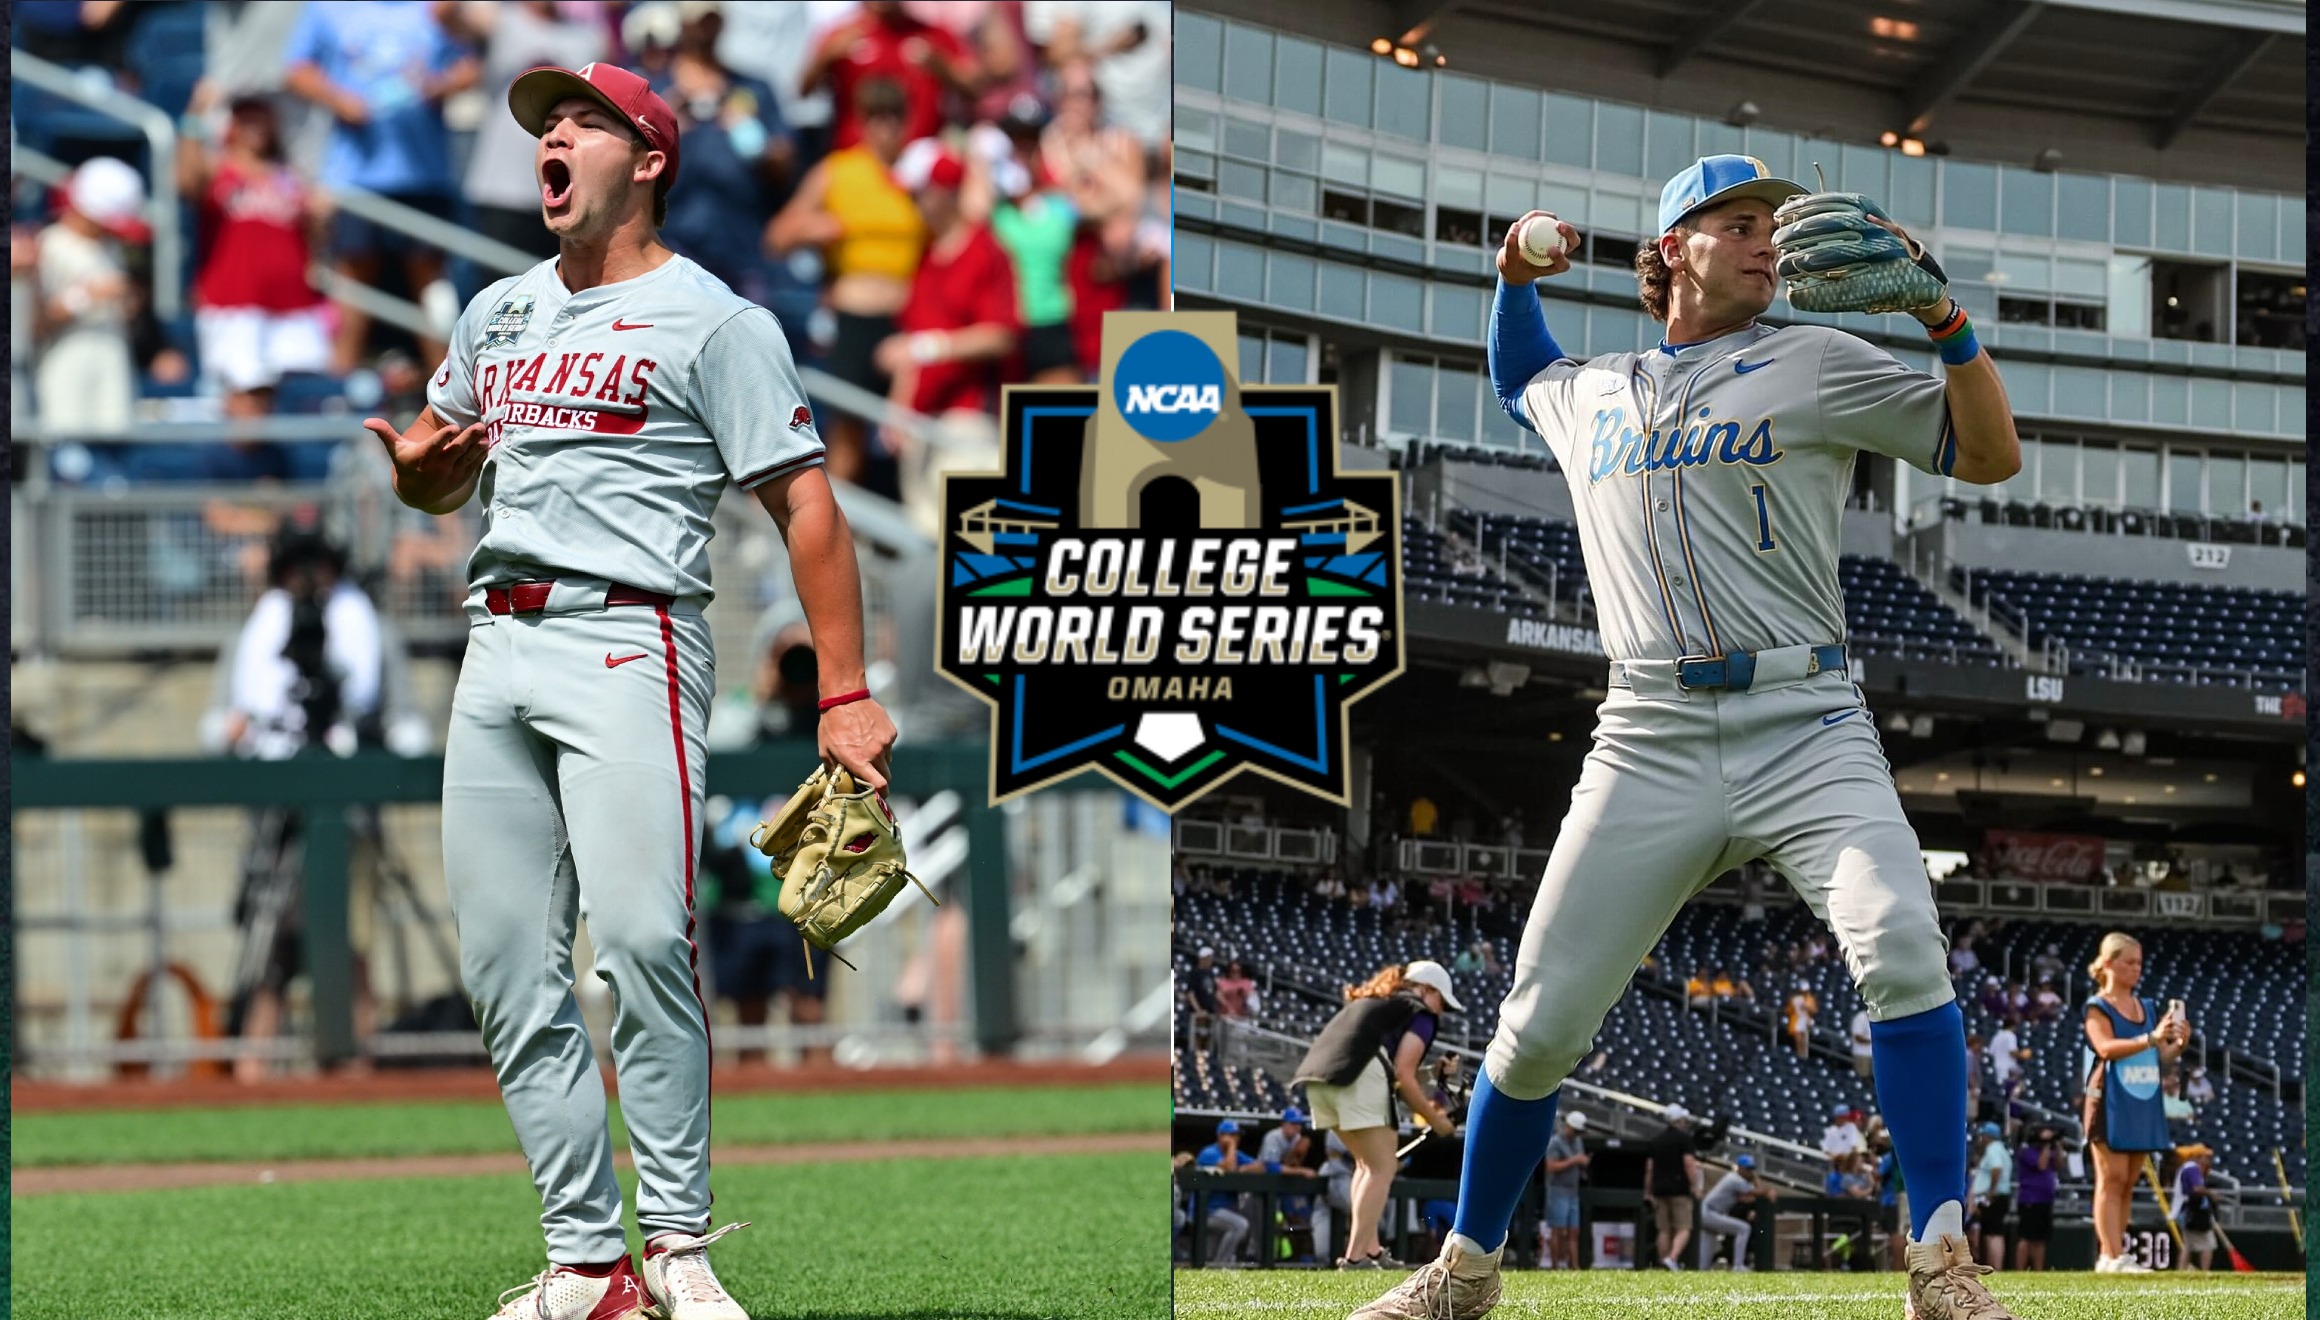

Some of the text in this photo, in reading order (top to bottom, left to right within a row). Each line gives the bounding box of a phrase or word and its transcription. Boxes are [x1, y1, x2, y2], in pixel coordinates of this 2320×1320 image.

[473, 352, 657, 416] ARKANSAS
[1588, 405, 1785, 489] Bruins
[1751, 483, 1777, 552] 1
[2194, 547, 2227, 563] 212
[2026, 675, 2063, 702] LSU
